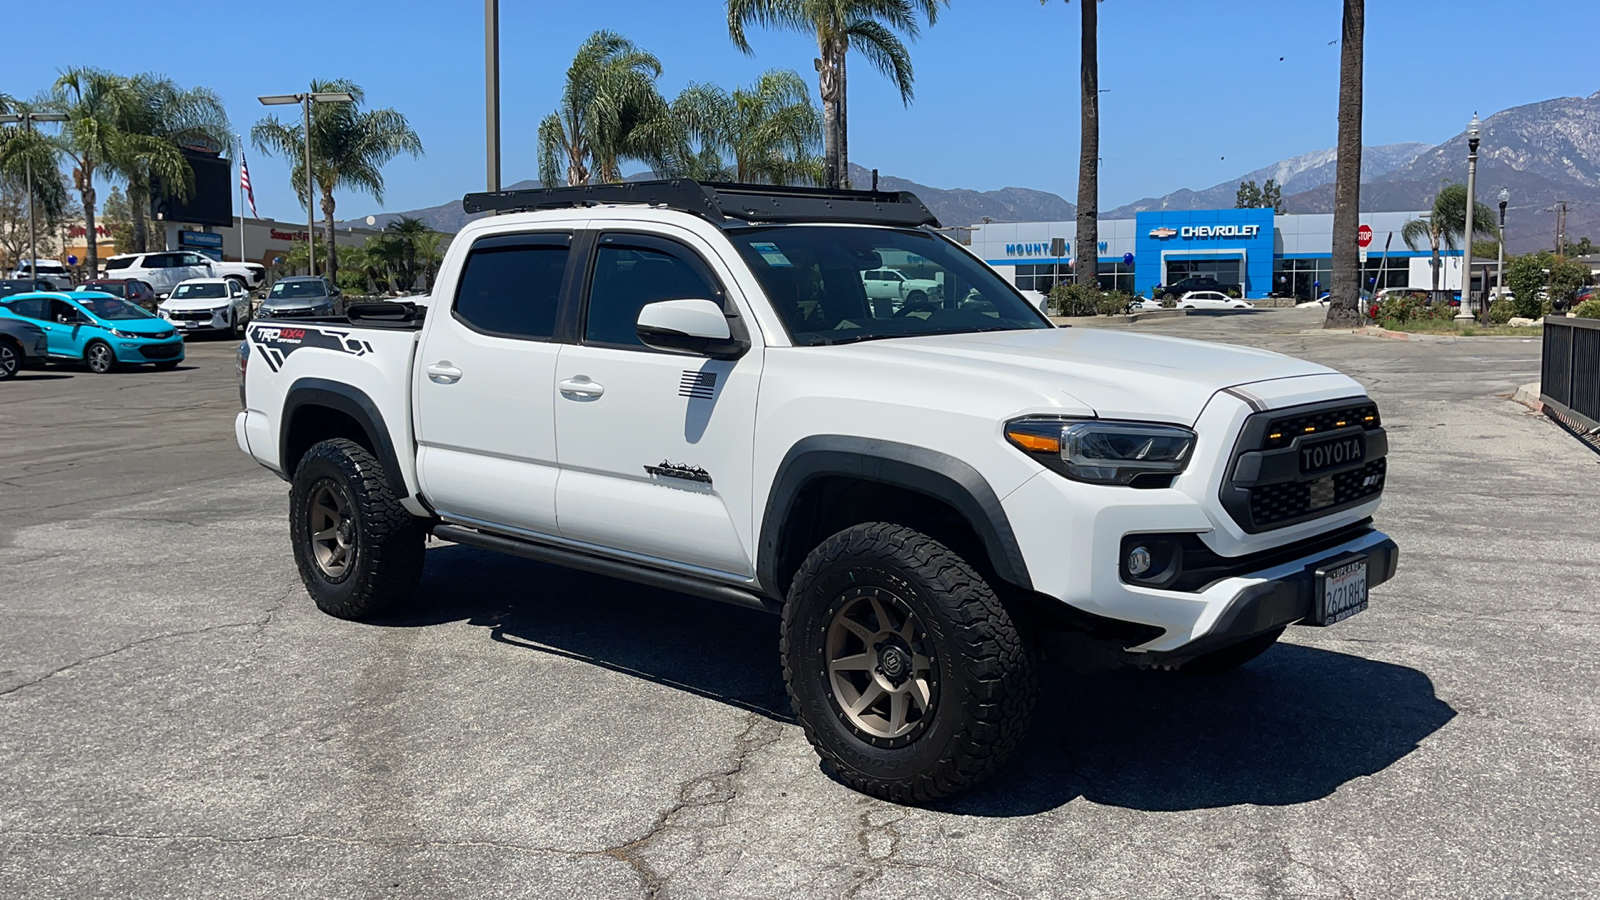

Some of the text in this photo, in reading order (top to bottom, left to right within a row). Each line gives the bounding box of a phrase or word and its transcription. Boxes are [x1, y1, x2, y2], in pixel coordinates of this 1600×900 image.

[1181, 225, 1260, 239] CHEVROLET
[1006, 243, 1070, 255] MOUNTN
[257, 328, 281, 342] TRD
[1302, 438, 1361, 470] TOYOTA
[1336, 562, 1359, 577] UPLAND
[1327, 578, 1365, 615] 26218H3
